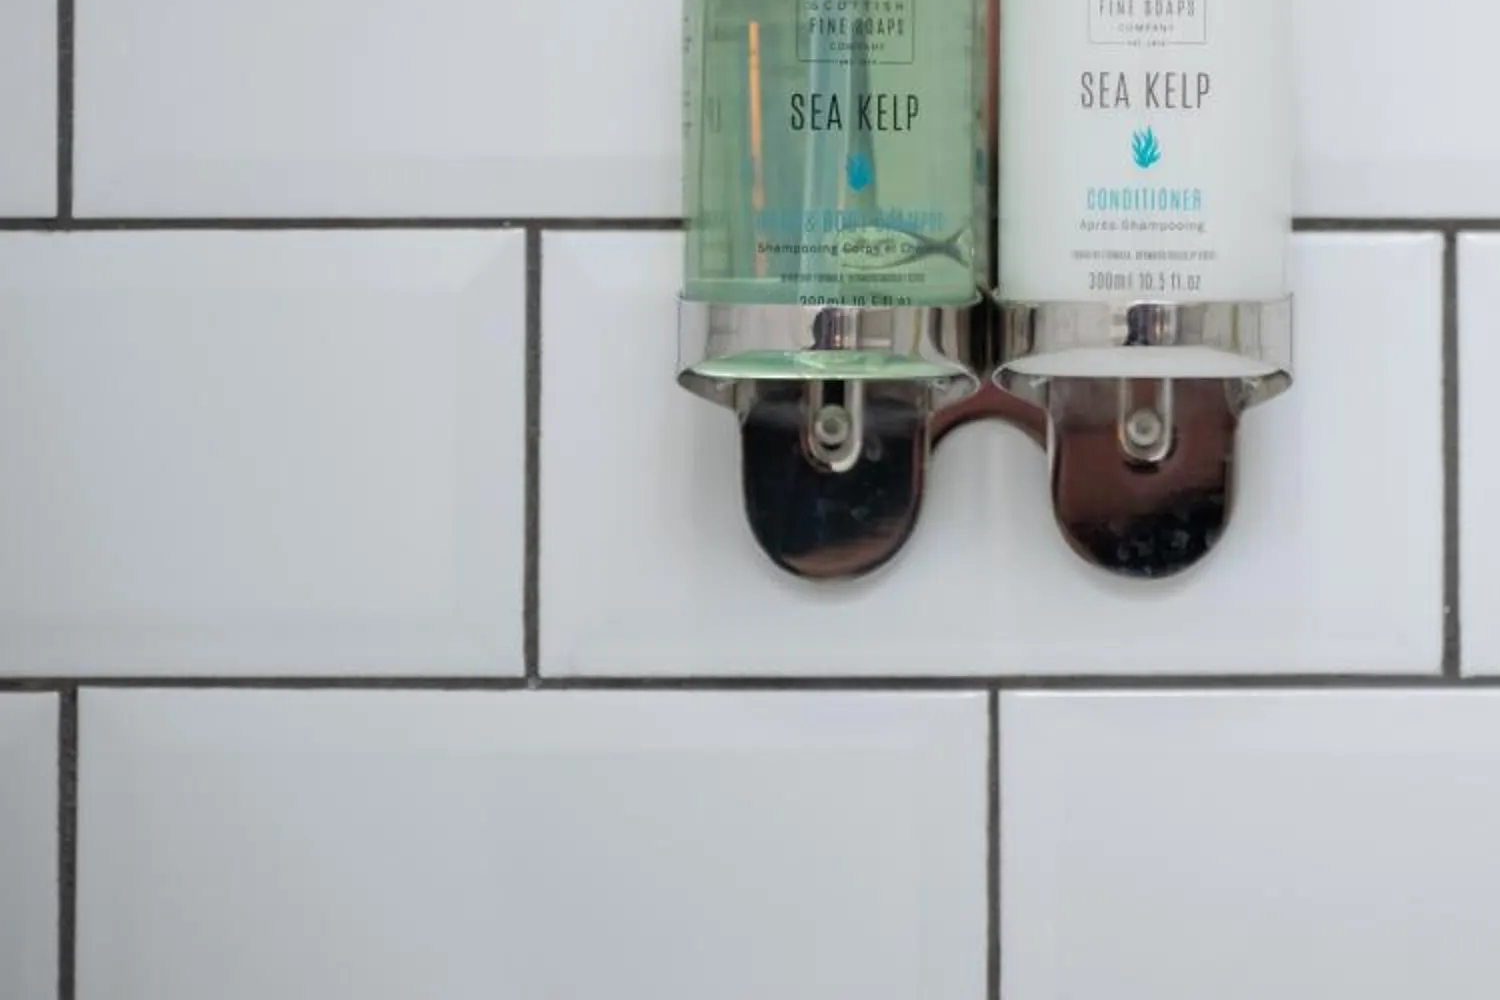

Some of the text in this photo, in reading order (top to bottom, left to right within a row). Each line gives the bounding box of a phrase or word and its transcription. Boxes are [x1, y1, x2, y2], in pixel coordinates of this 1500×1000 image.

[809, 17, 846, 35] FINE
[1081, 71, 1210, 109] SEA KELP
[791, 92, 919, 131] SEA KELP
[1086, 187, 1201, 211] CONDITIONER
